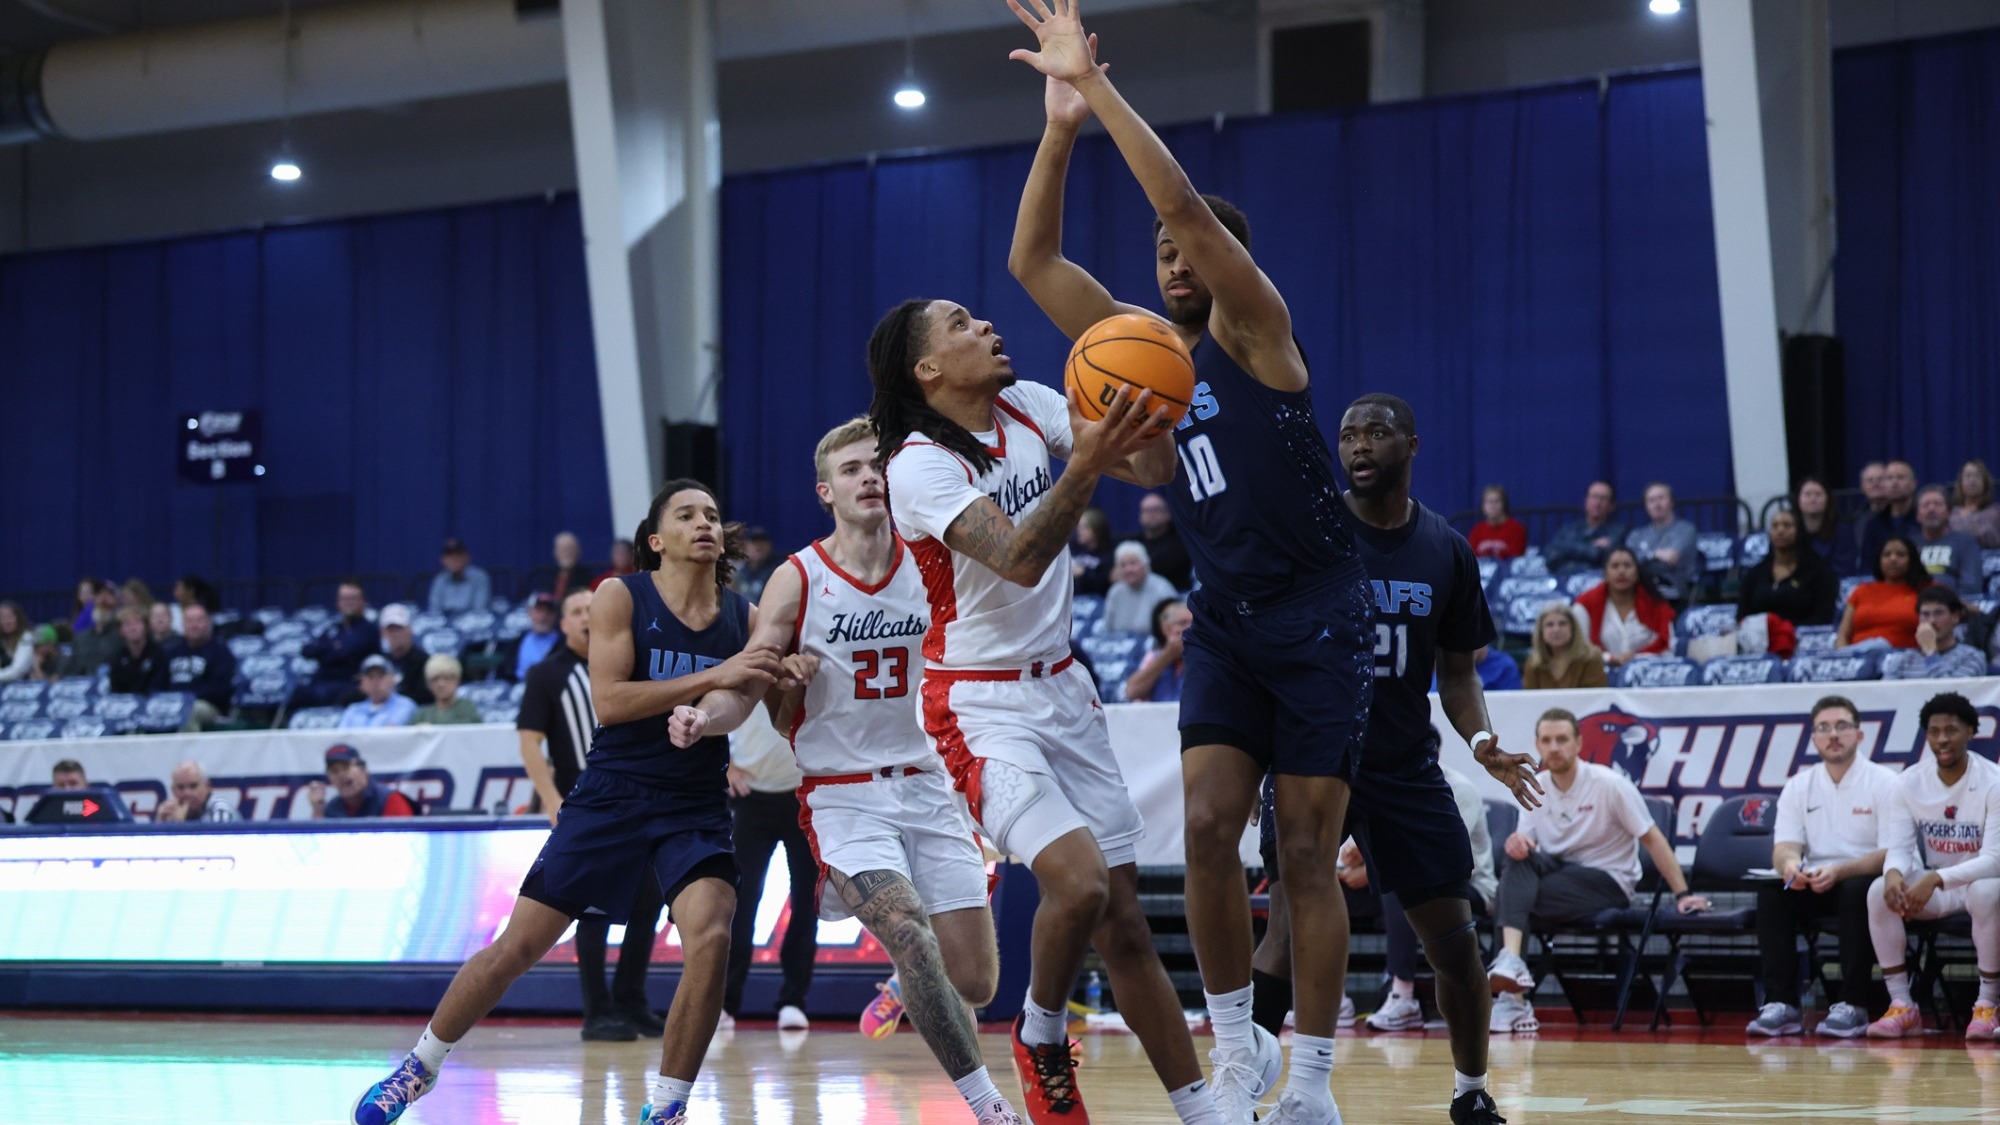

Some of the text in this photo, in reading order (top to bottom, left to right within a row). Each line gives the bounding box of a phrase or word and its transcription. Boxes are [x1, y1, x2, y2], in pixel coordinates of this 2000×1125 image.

[187, 440, 252, 461] Section
[1178, 433, 1227, 502] 10
[825, 609, 927, 644] Hillcats
[649, 648, 726, 681] UAF
[852, 645, 909, 700] 23
[1373, 622, 1408, 678] 21
